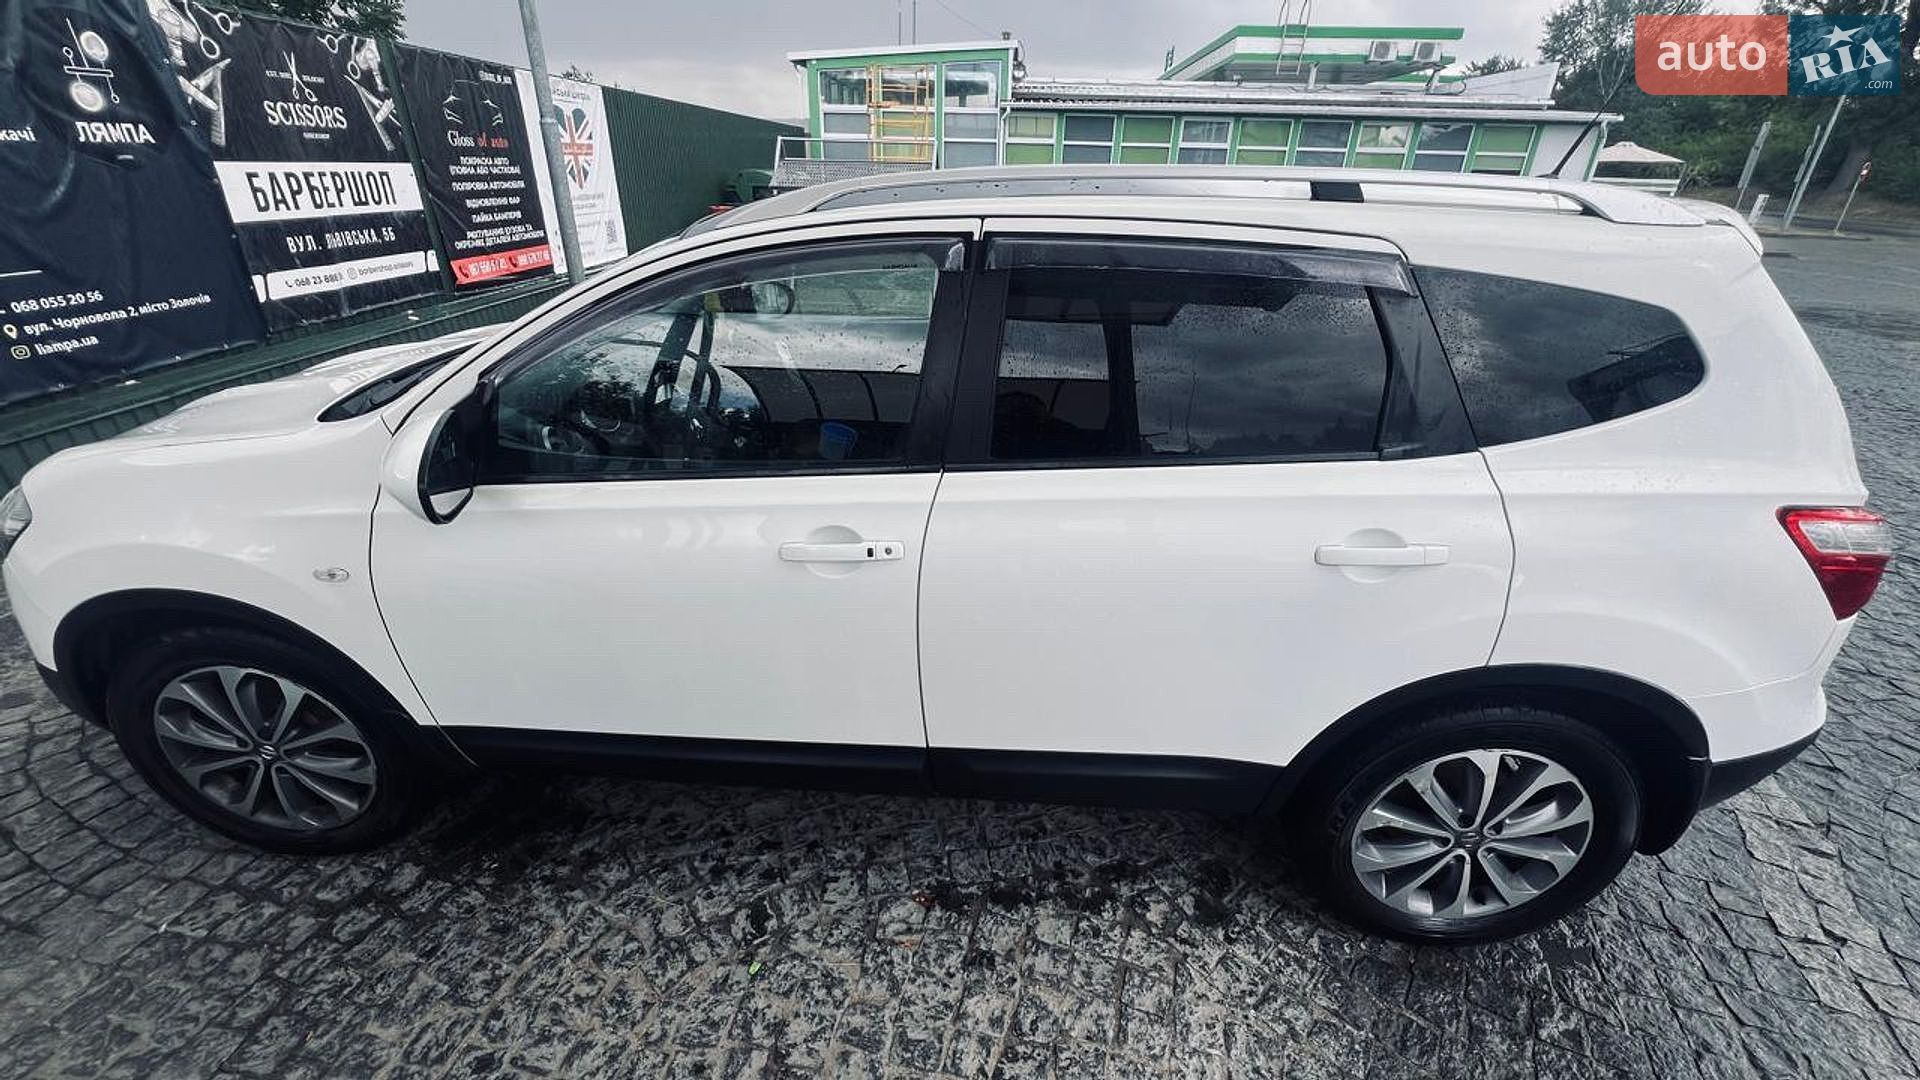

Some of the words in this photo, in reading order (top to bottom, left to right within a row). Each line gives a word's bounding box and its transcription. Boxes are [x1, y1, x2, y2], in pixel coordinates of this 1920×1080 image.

[263, 100, 347, 129] SCISSORS
[75, 121, 156, 144] ЛЯМПА
[447, 130, 475, 147] Gloss
[245, 170, 397, 213] БАРБЕРШОП
[286, 234, 322, 253] ВУЛ.
[10, 298, 39, 314] 068
[40, 294, 66, 310] 055
[67, 292, 86, 305] 20
[87, 290, 104, 303] 56
[23, 322, 53, 336] вул.
[52, 309, 128, 331] Чорновола
[139, 301, 170, 315] місто
[168, 293, 212, 309] Золочів
[34, 334, 99, 356] liampa.ua
